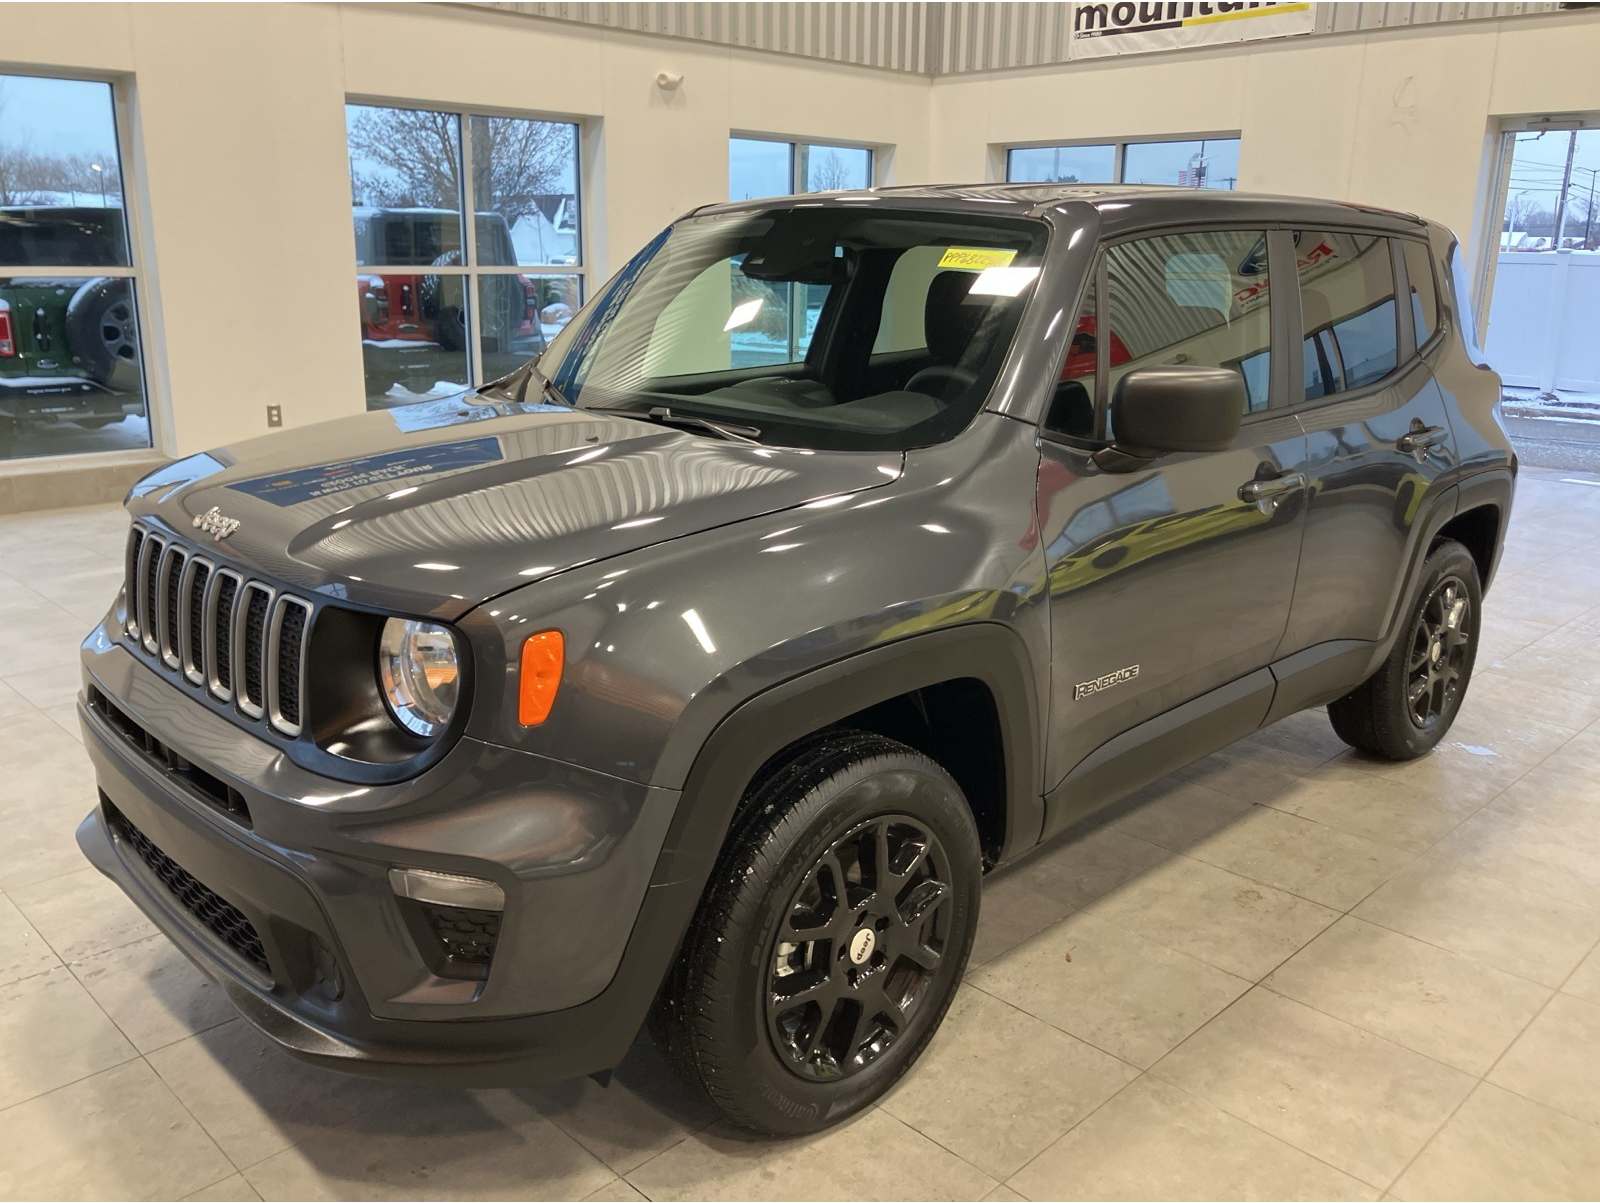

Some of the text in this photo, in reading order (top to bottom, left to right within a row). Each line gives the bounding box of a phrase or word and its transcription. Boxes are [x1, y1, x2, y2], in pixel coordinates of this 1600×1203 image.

[1074, 2, 1297, 31] moun
[192, 506, 240, 541] Jeep
[1073, 664, 1140, 701] RENEGADE
[856, 932, 871, 961] Jeep
